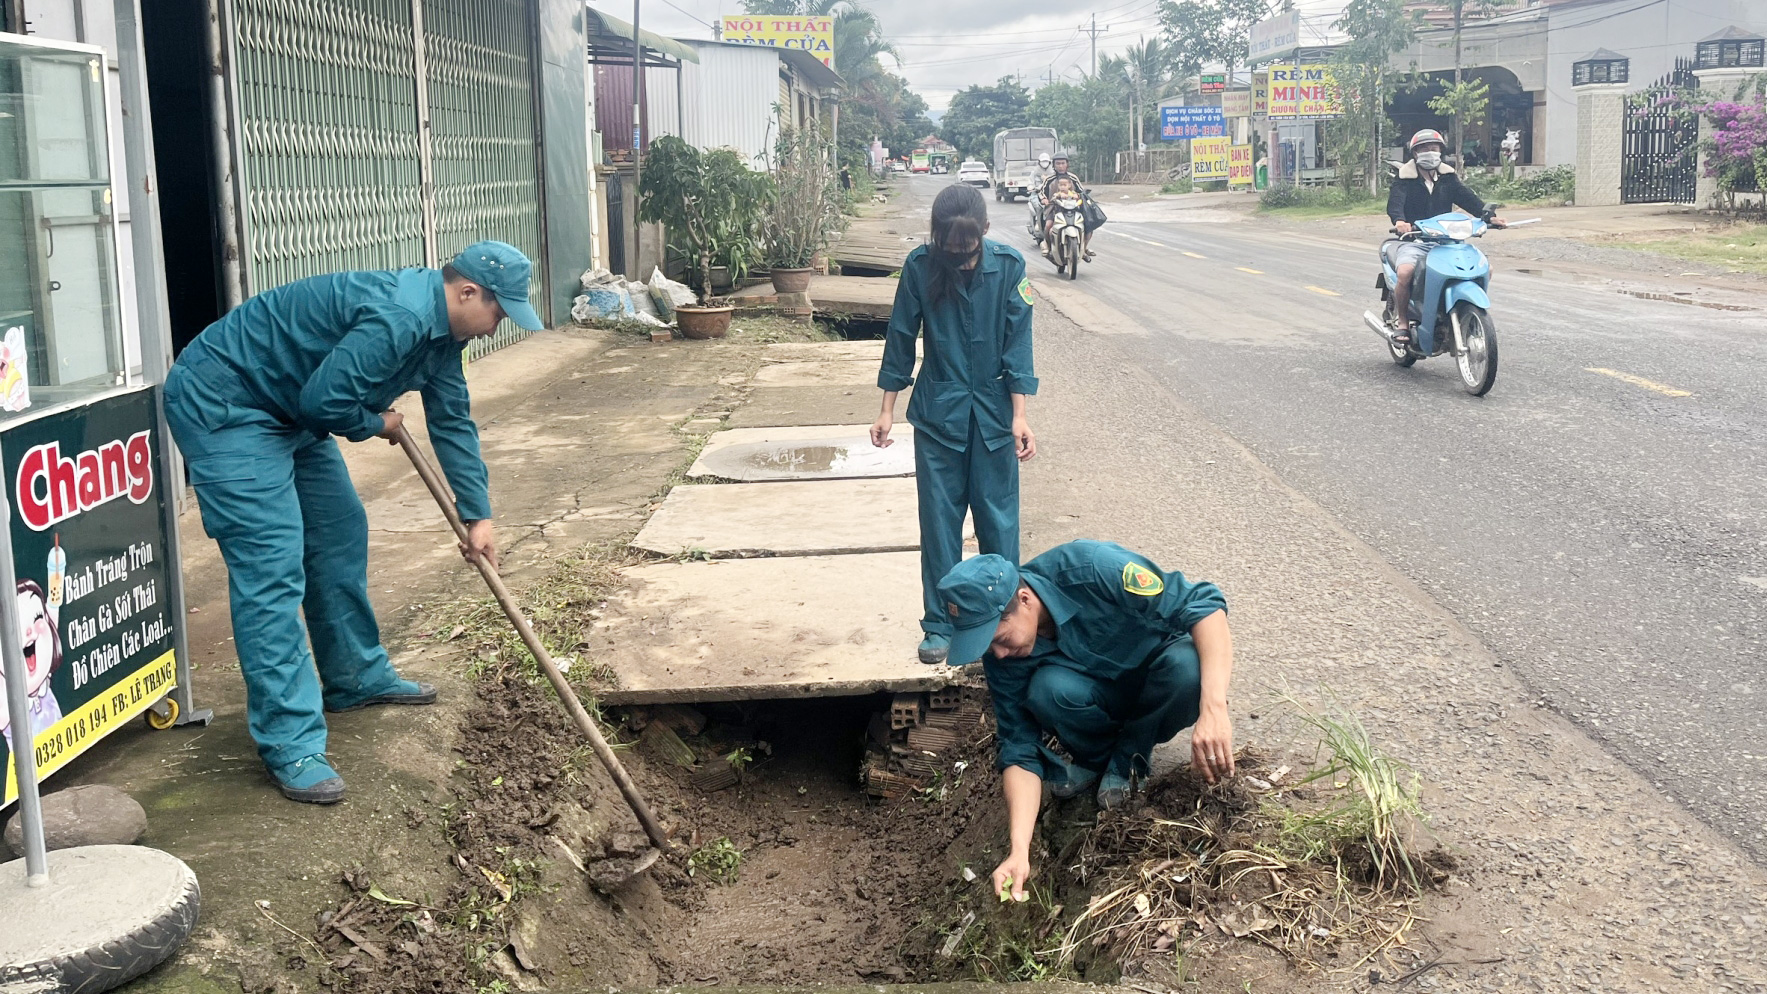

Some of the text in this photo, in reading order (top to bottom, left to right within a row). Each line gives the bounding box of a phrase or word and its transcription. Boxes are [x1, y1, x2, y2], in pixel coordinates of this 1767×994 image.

[725, 17, 831, 33] NỘI THẤT
[784, 34, 831, 50] CỬA
[1272, 67, 1324, 80] RÈM
[1272, 85, 1326, 101] MINH
[1180, 115, 1190, 123] NỘI
[1175, 126, 1183, 136] XE
[1185, 124, 1189, 136] Ô
[1190, 124, 1198, 135] TÔ
[1202, 126, 1209, 135] XE
[1210, 123, 1222, 135] MÁY
[1194, 142, 1207, 156] NỘI
[1243, 149, 1249, 160] XE
[1194, 159, 1211, 173] RÈM
[16, 429, 153, 532] Chang
[65, 541, 154, 605] Bánh Tráng Trộn
[68, 579, 156, 650] Chân Gà Sốt Thái
[72, 612, 173, 690] Đồ Chiên Các Loại...
[36, 662, 172, 768] 0328 018 194 FB: LÊ TRANG
